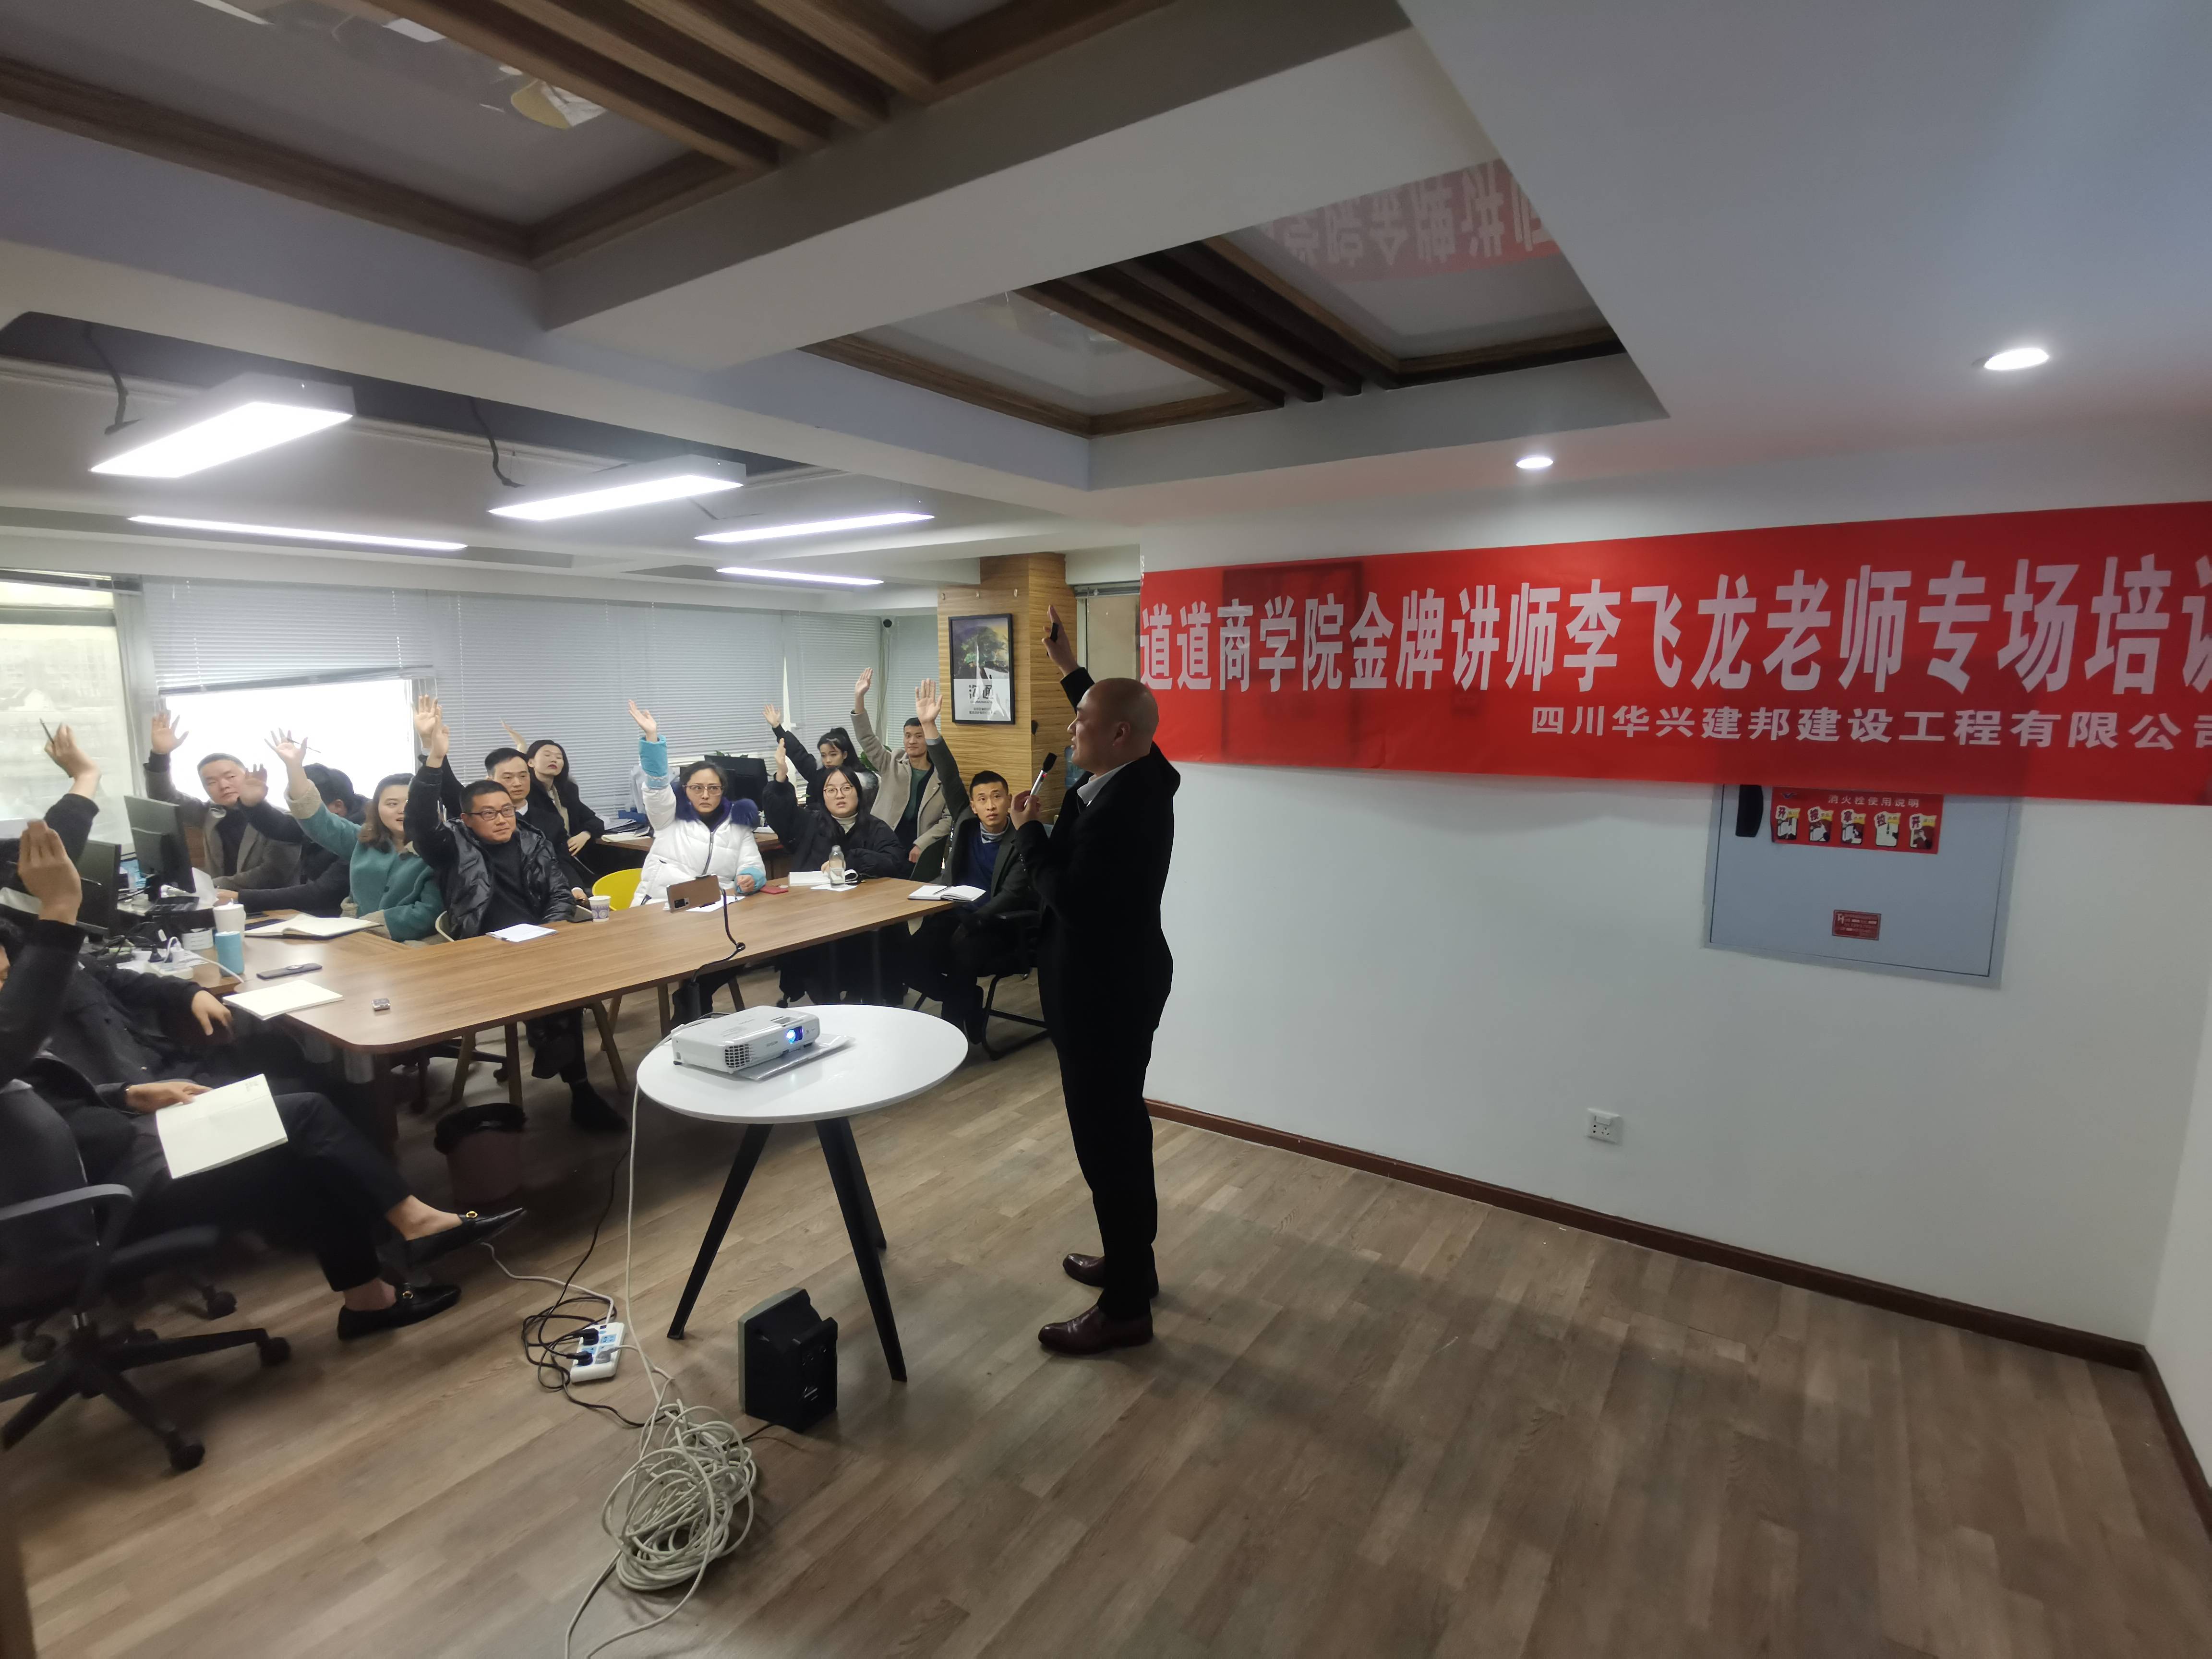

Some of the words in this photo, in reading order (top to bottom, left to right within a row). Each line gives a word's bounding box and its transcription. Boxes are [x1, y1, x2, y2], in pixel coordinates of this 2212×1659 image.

[1827, 794, 1920, 808] 消火栓使用说明
